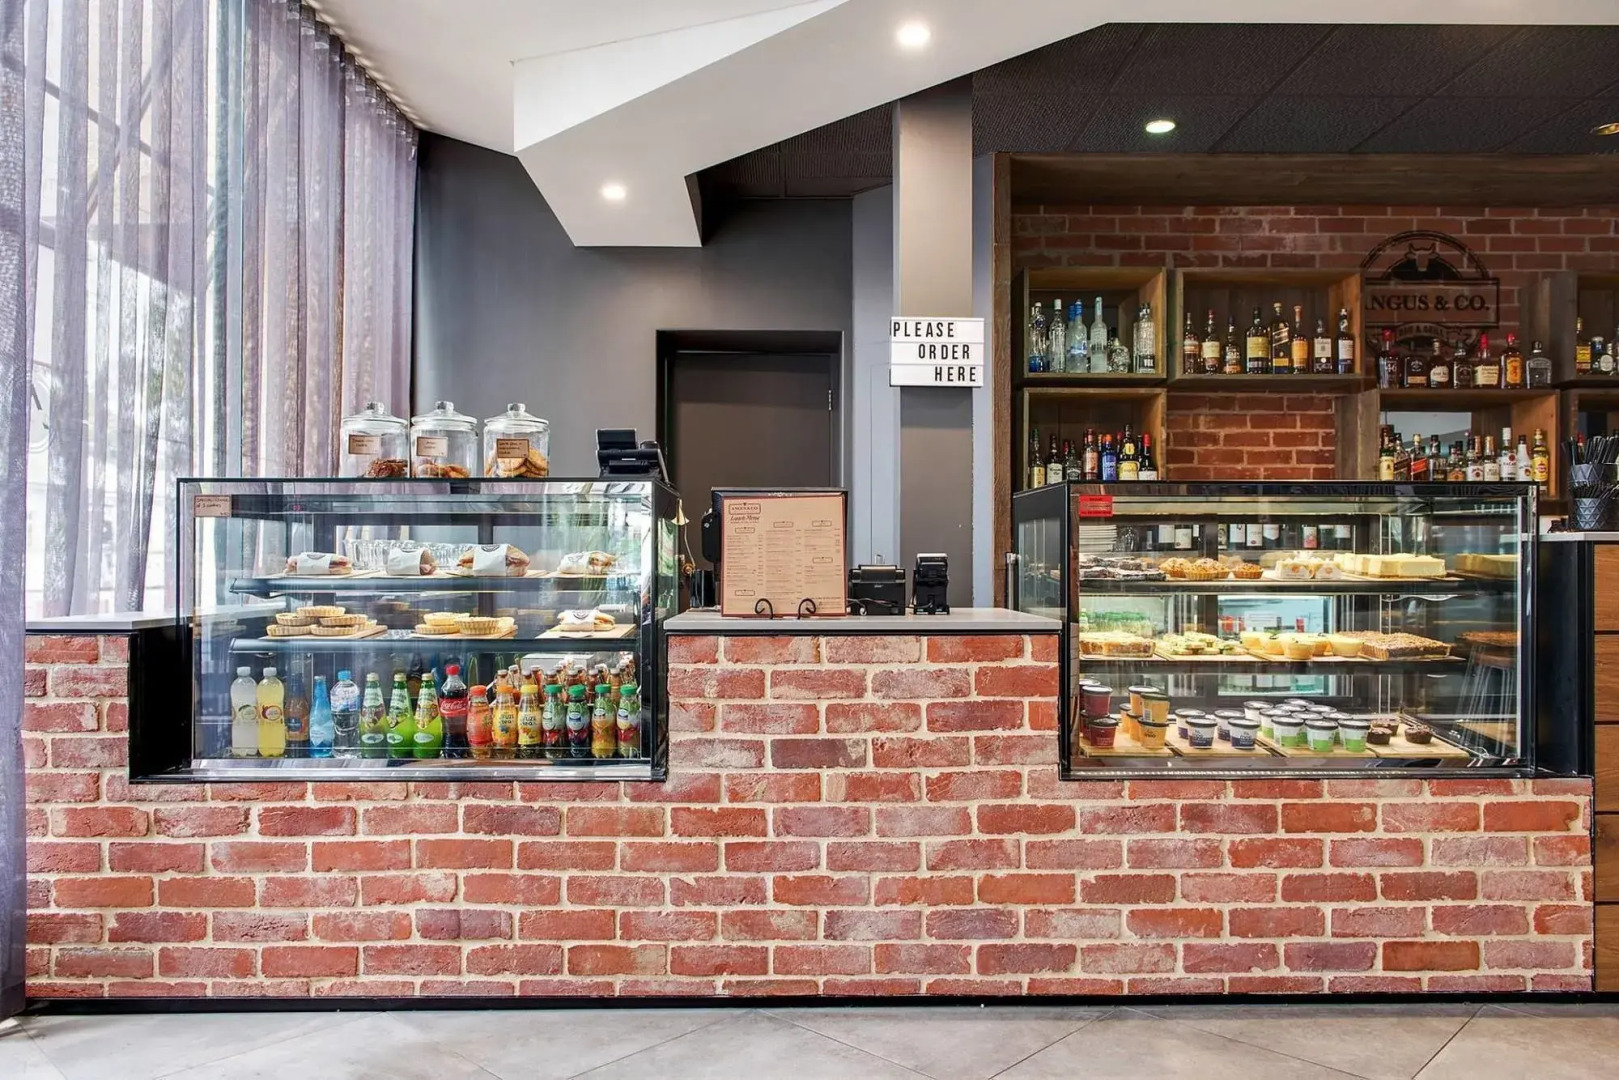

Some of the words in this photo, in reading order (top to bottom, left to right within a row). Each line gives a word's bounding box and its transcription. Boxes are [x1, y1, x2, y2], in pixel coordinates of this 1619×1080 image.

[1364, 295, 1430, 311] NGUS
[1434, 295, 1450, 311] &
[1454, 295, 1490, 311] CO.
[893, 321, 954, 338] PLEASE
[918, 343, 970, 360] ORDER
[934, 366, 976, 382] HERE
